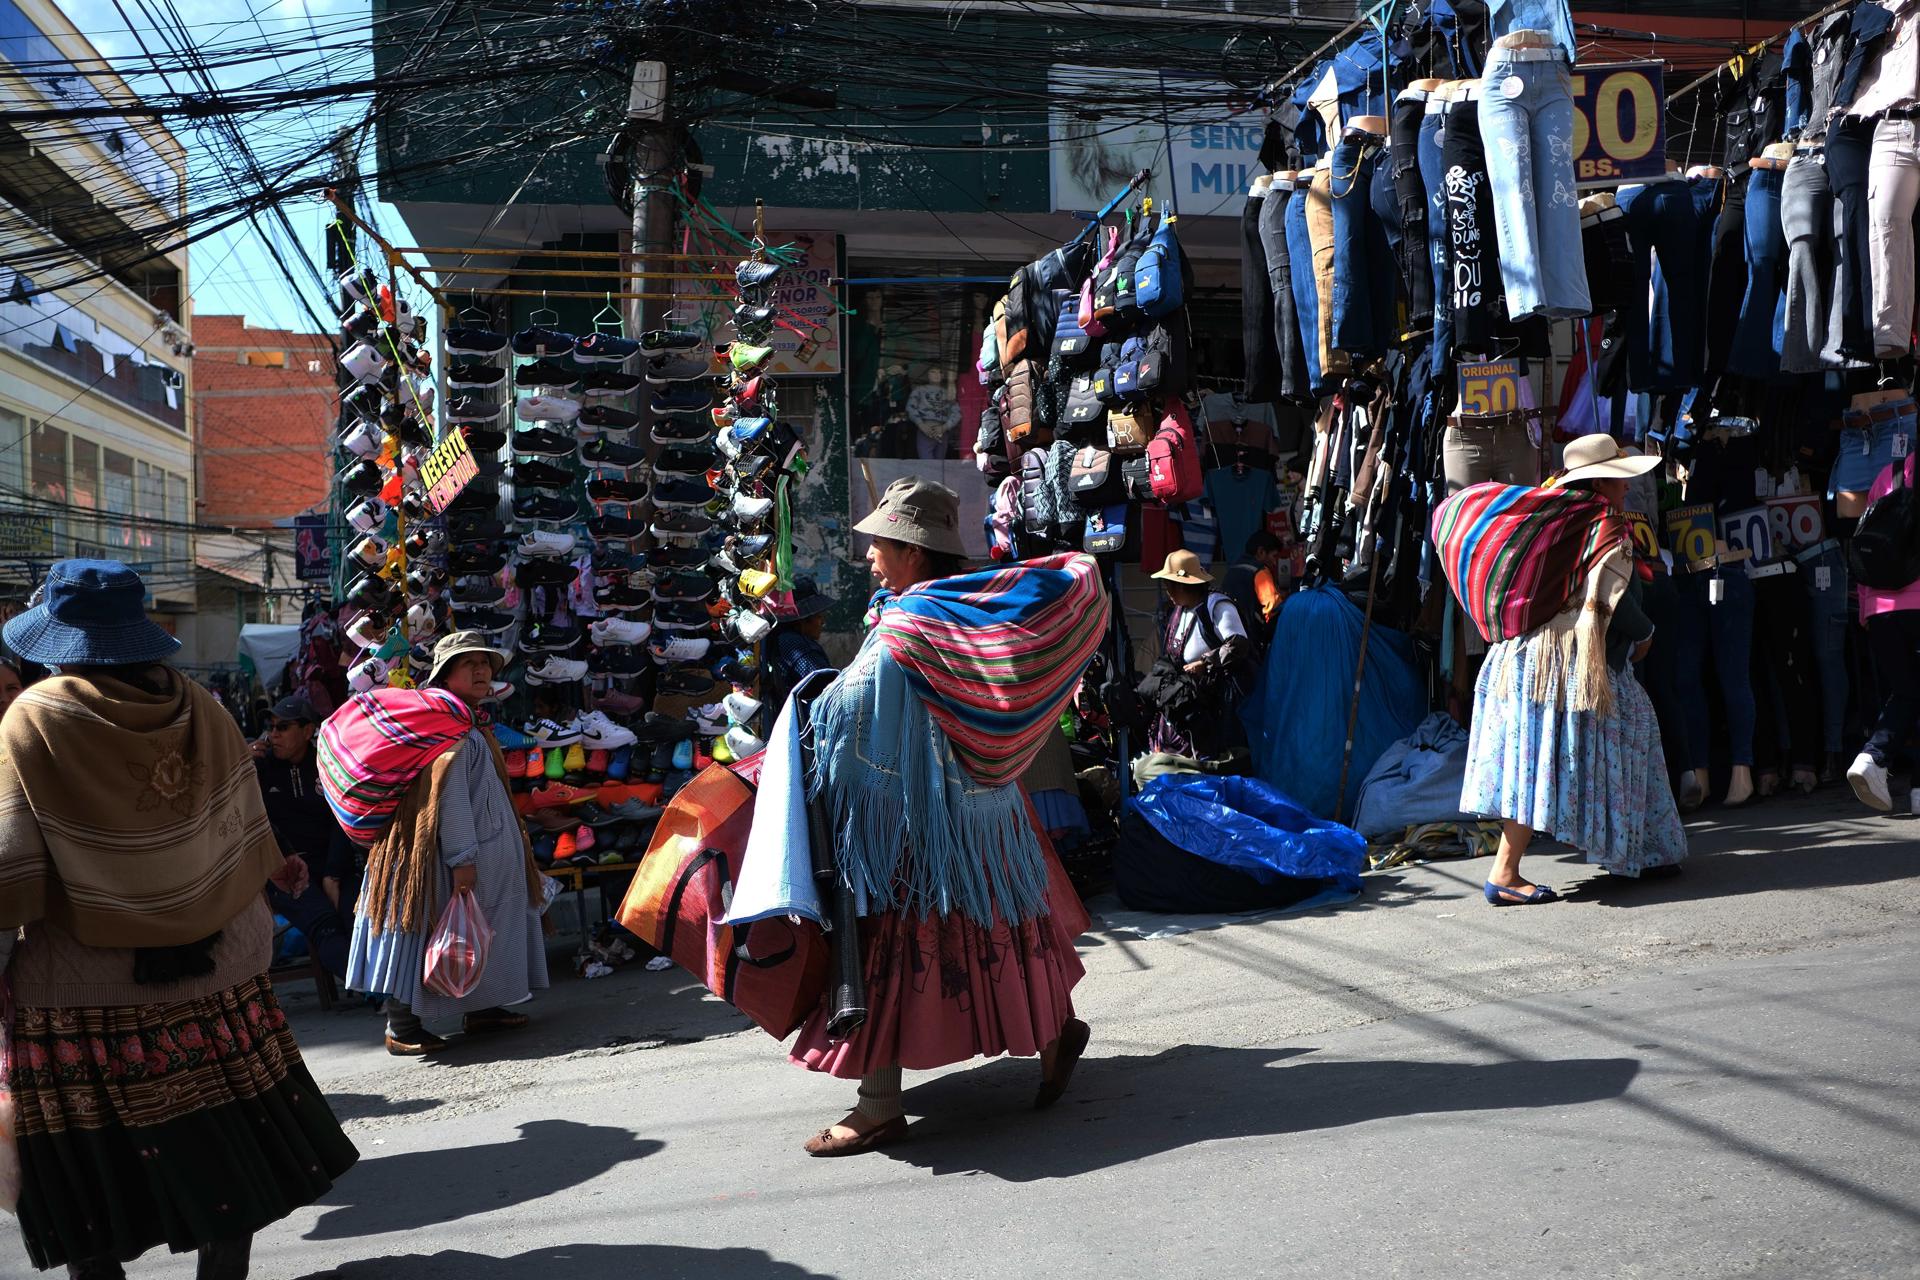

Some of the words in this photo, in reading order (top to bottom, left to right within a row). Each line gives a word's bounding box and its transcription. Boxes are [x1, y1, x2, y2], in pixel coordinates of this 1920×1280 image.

[1579, 159, 1621, 177] BS.
[1462, 363, 1516, 377] ORIGINAL
[1465, 377, 1516, 415] 50
[1666, 506, 1714, 520] ORIGINAL
[1770, 503, 1822, 546] 80
[1668, 519, 1714, 561] 70
[1725, 515, 1769, 568] 50
